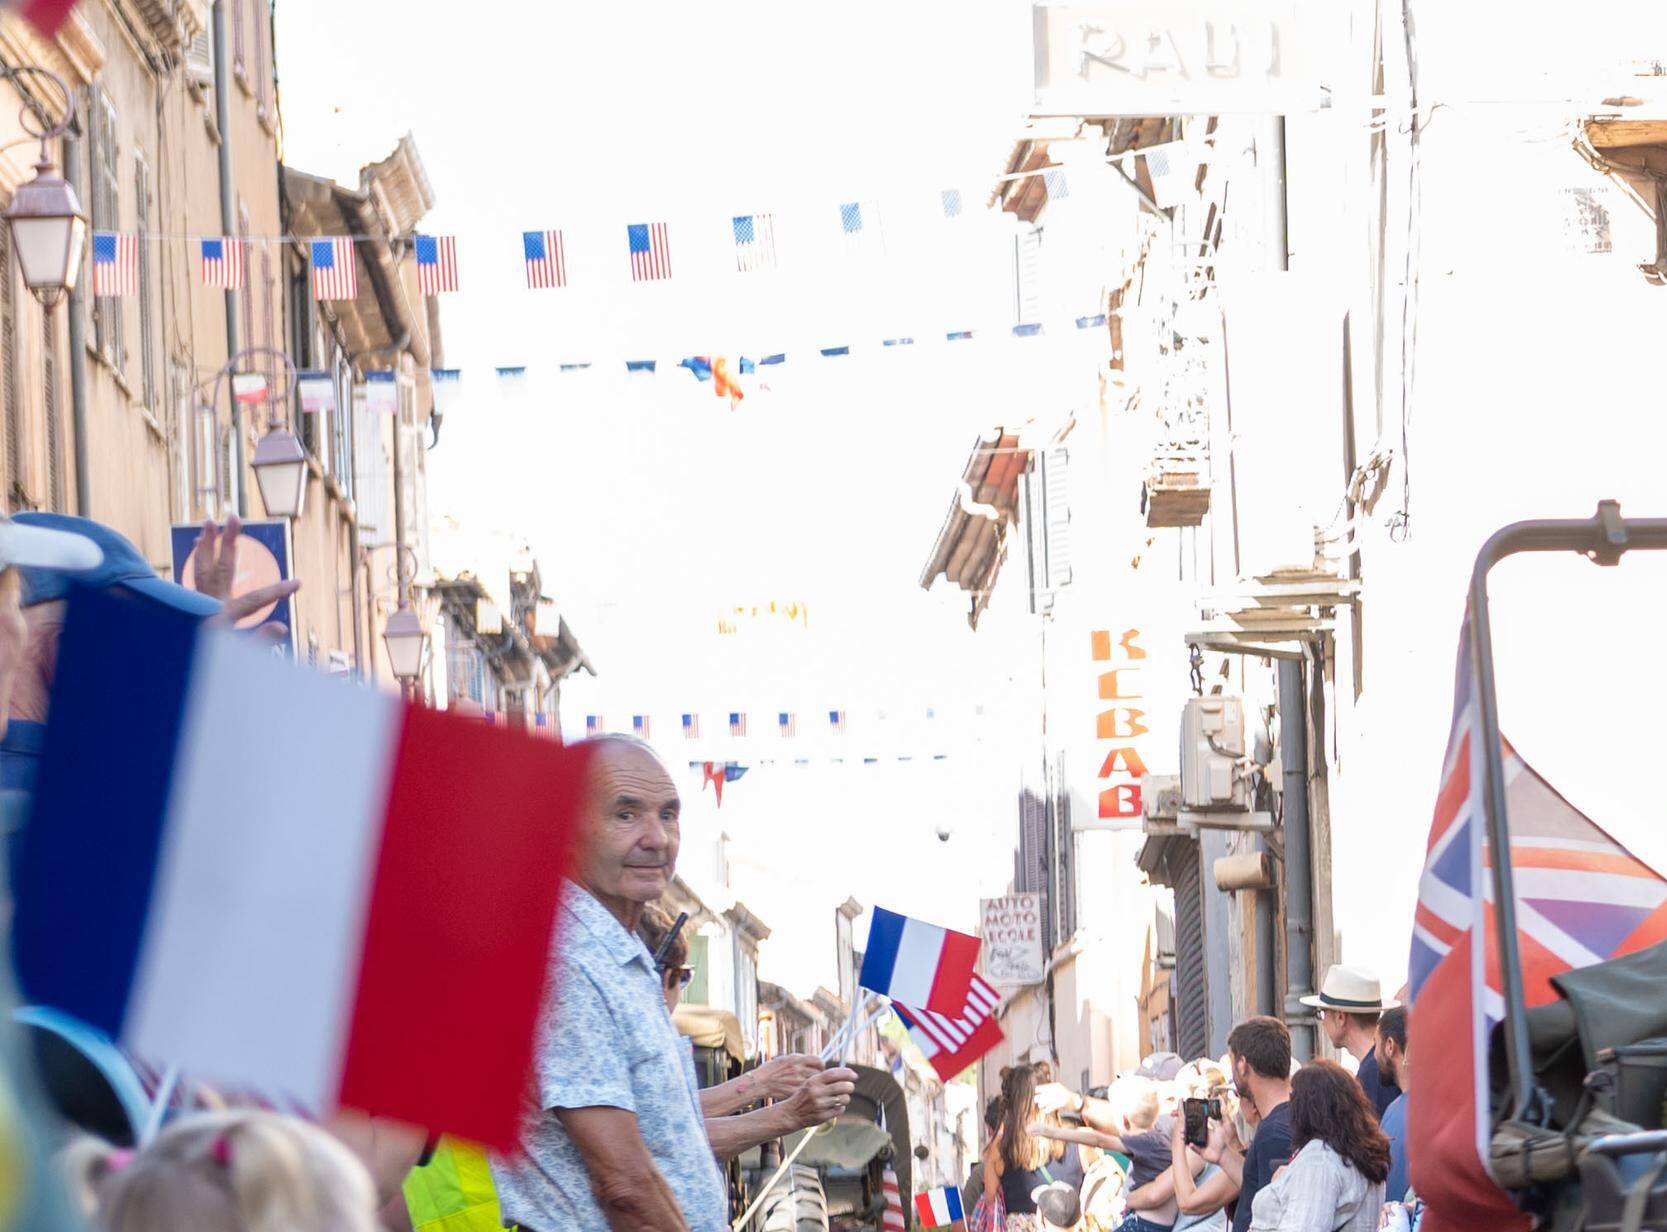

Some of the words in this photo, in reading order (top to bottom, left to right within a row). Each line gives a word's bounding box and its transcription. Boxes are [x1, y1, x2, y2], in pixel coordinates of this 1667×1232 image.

[1091, 628, 1148, 819] KEBAB
[986, 896, 1034, 911] AUTO
[984, 911, 1038, 927] MOTO
